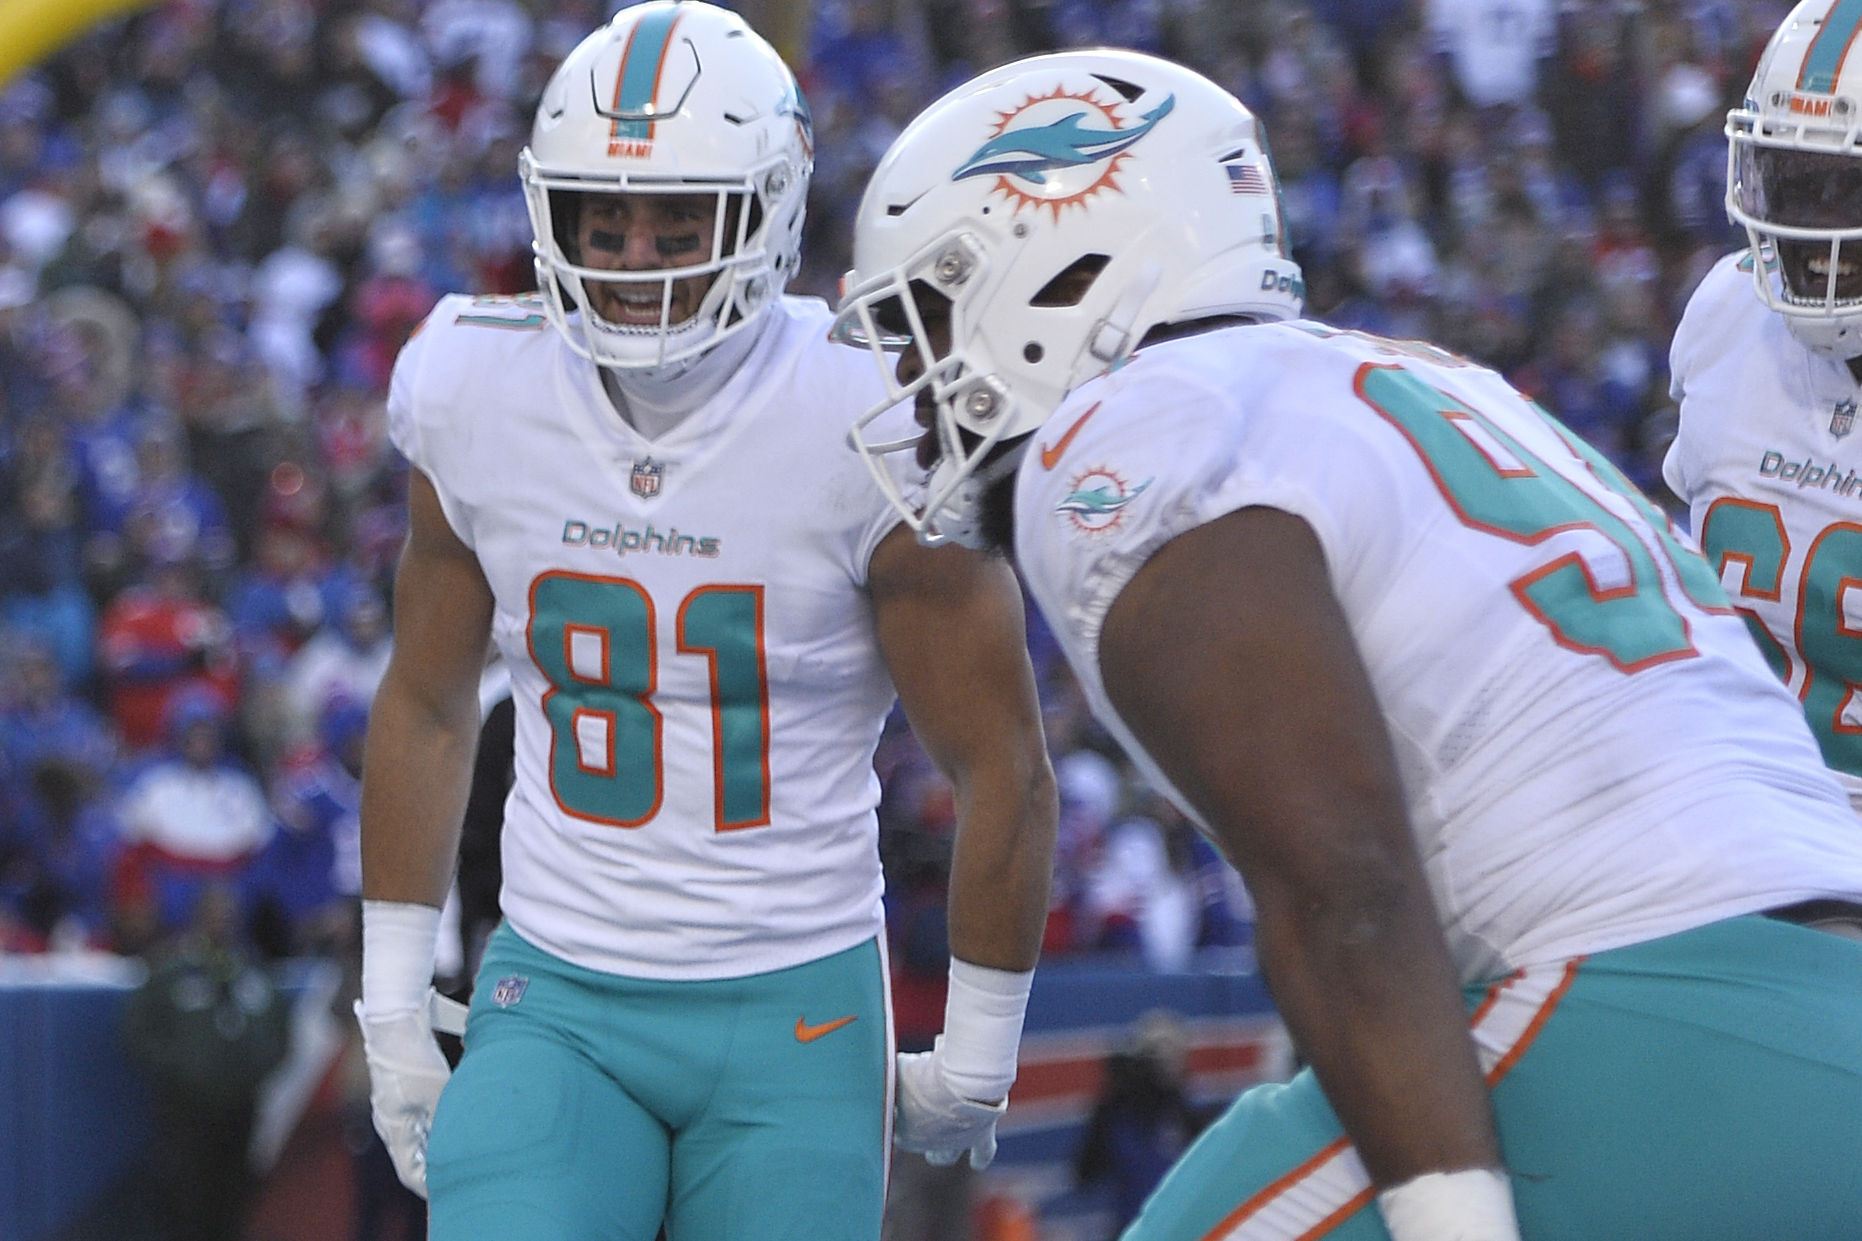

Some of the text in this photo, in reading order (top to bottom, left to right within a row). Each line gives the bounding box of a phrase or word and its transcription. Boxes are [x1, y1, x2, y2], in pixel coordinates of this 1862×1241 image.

[608, 143, 652, 159] MIAMI
[634, 475, 658, 492] NFL
[1759, 450, 1862, 501] Dolphin
[562, 520, 722, 558] Dolphins
[526, 569, 771, 832] 81
